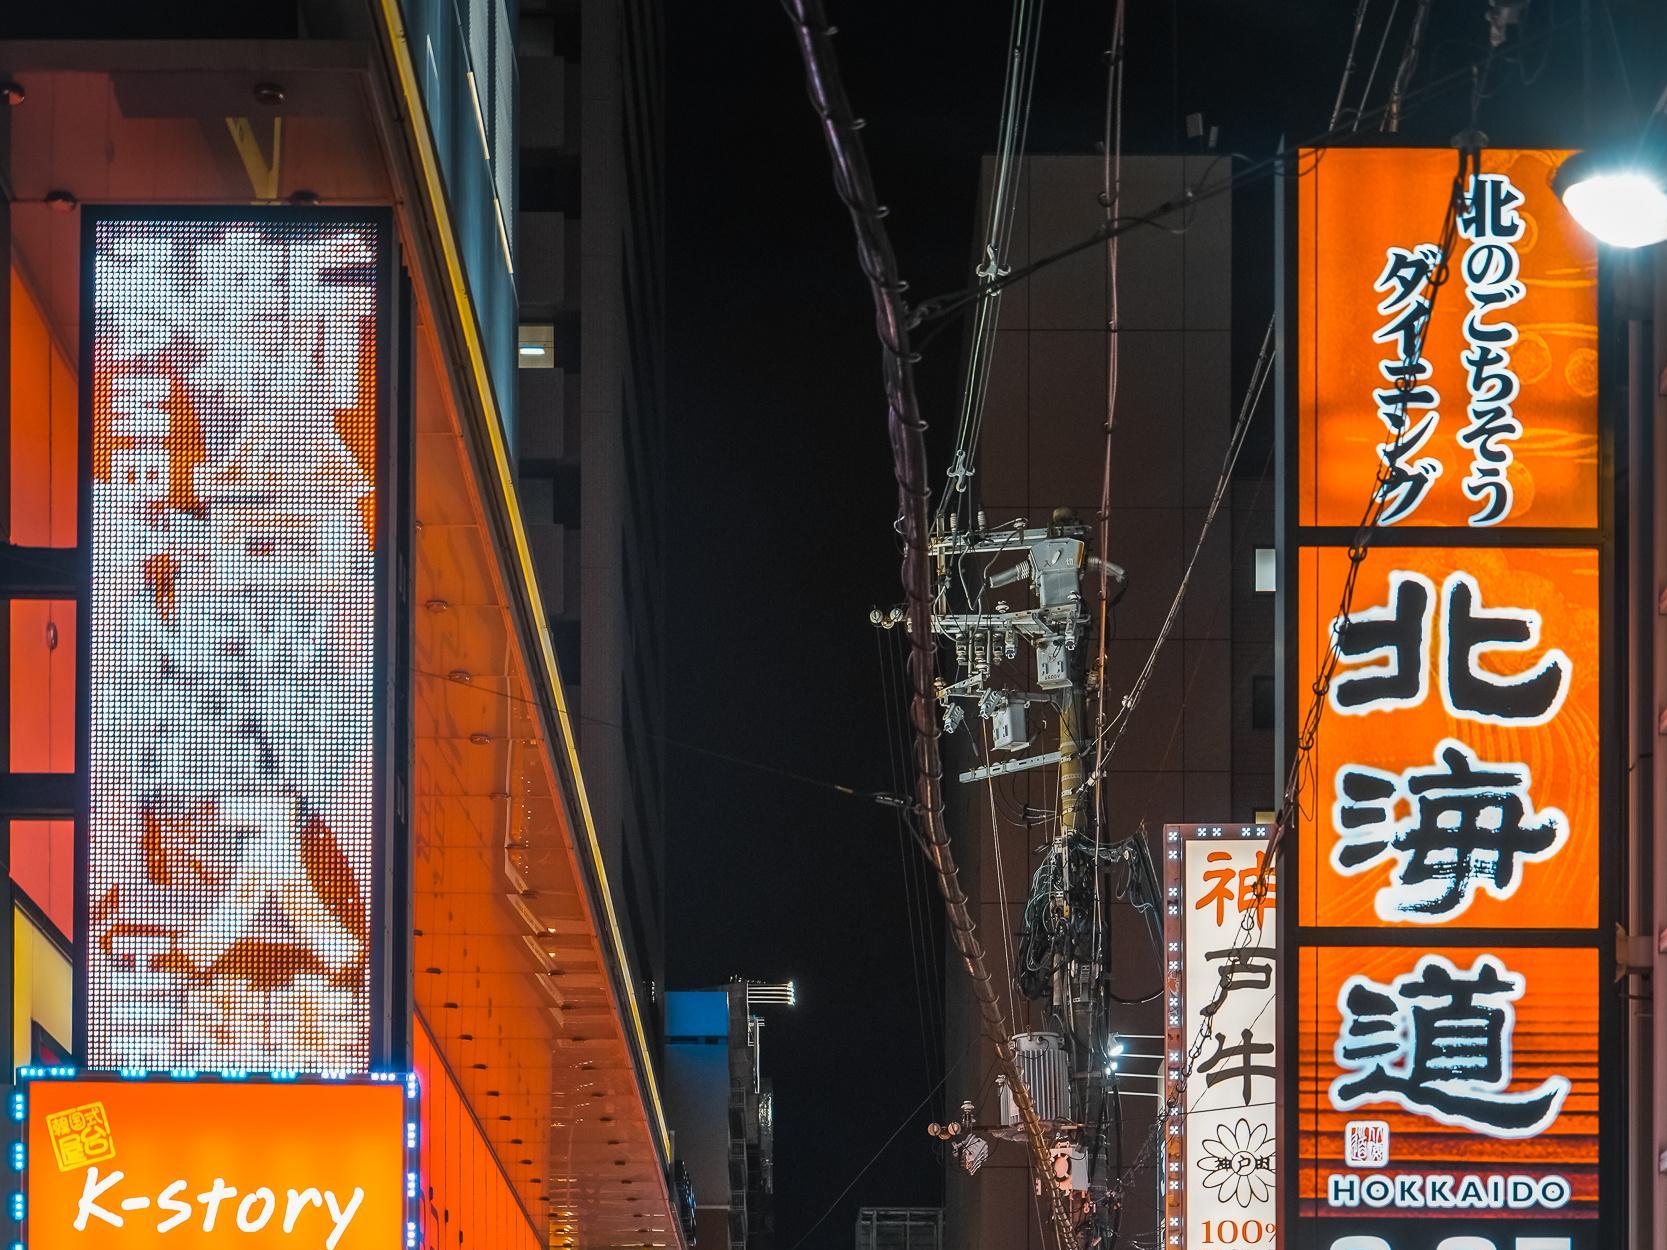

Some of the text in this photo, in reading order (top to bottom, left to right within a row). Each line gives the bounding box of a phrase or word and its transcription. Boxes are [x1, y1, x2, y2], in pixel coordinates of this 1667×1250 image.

[1375, 246, 1440, 526] ダイニング
[1459, 176, 1527, 526] 北のごちそう
[1196, 851, 1276, 1107] 神戸牛
[1333, 574, 1571, 1134] 北海道
[73, 1166, 365, 1250] K-story
[1331, 1177, 1567, 1205] HOKKAIDO
